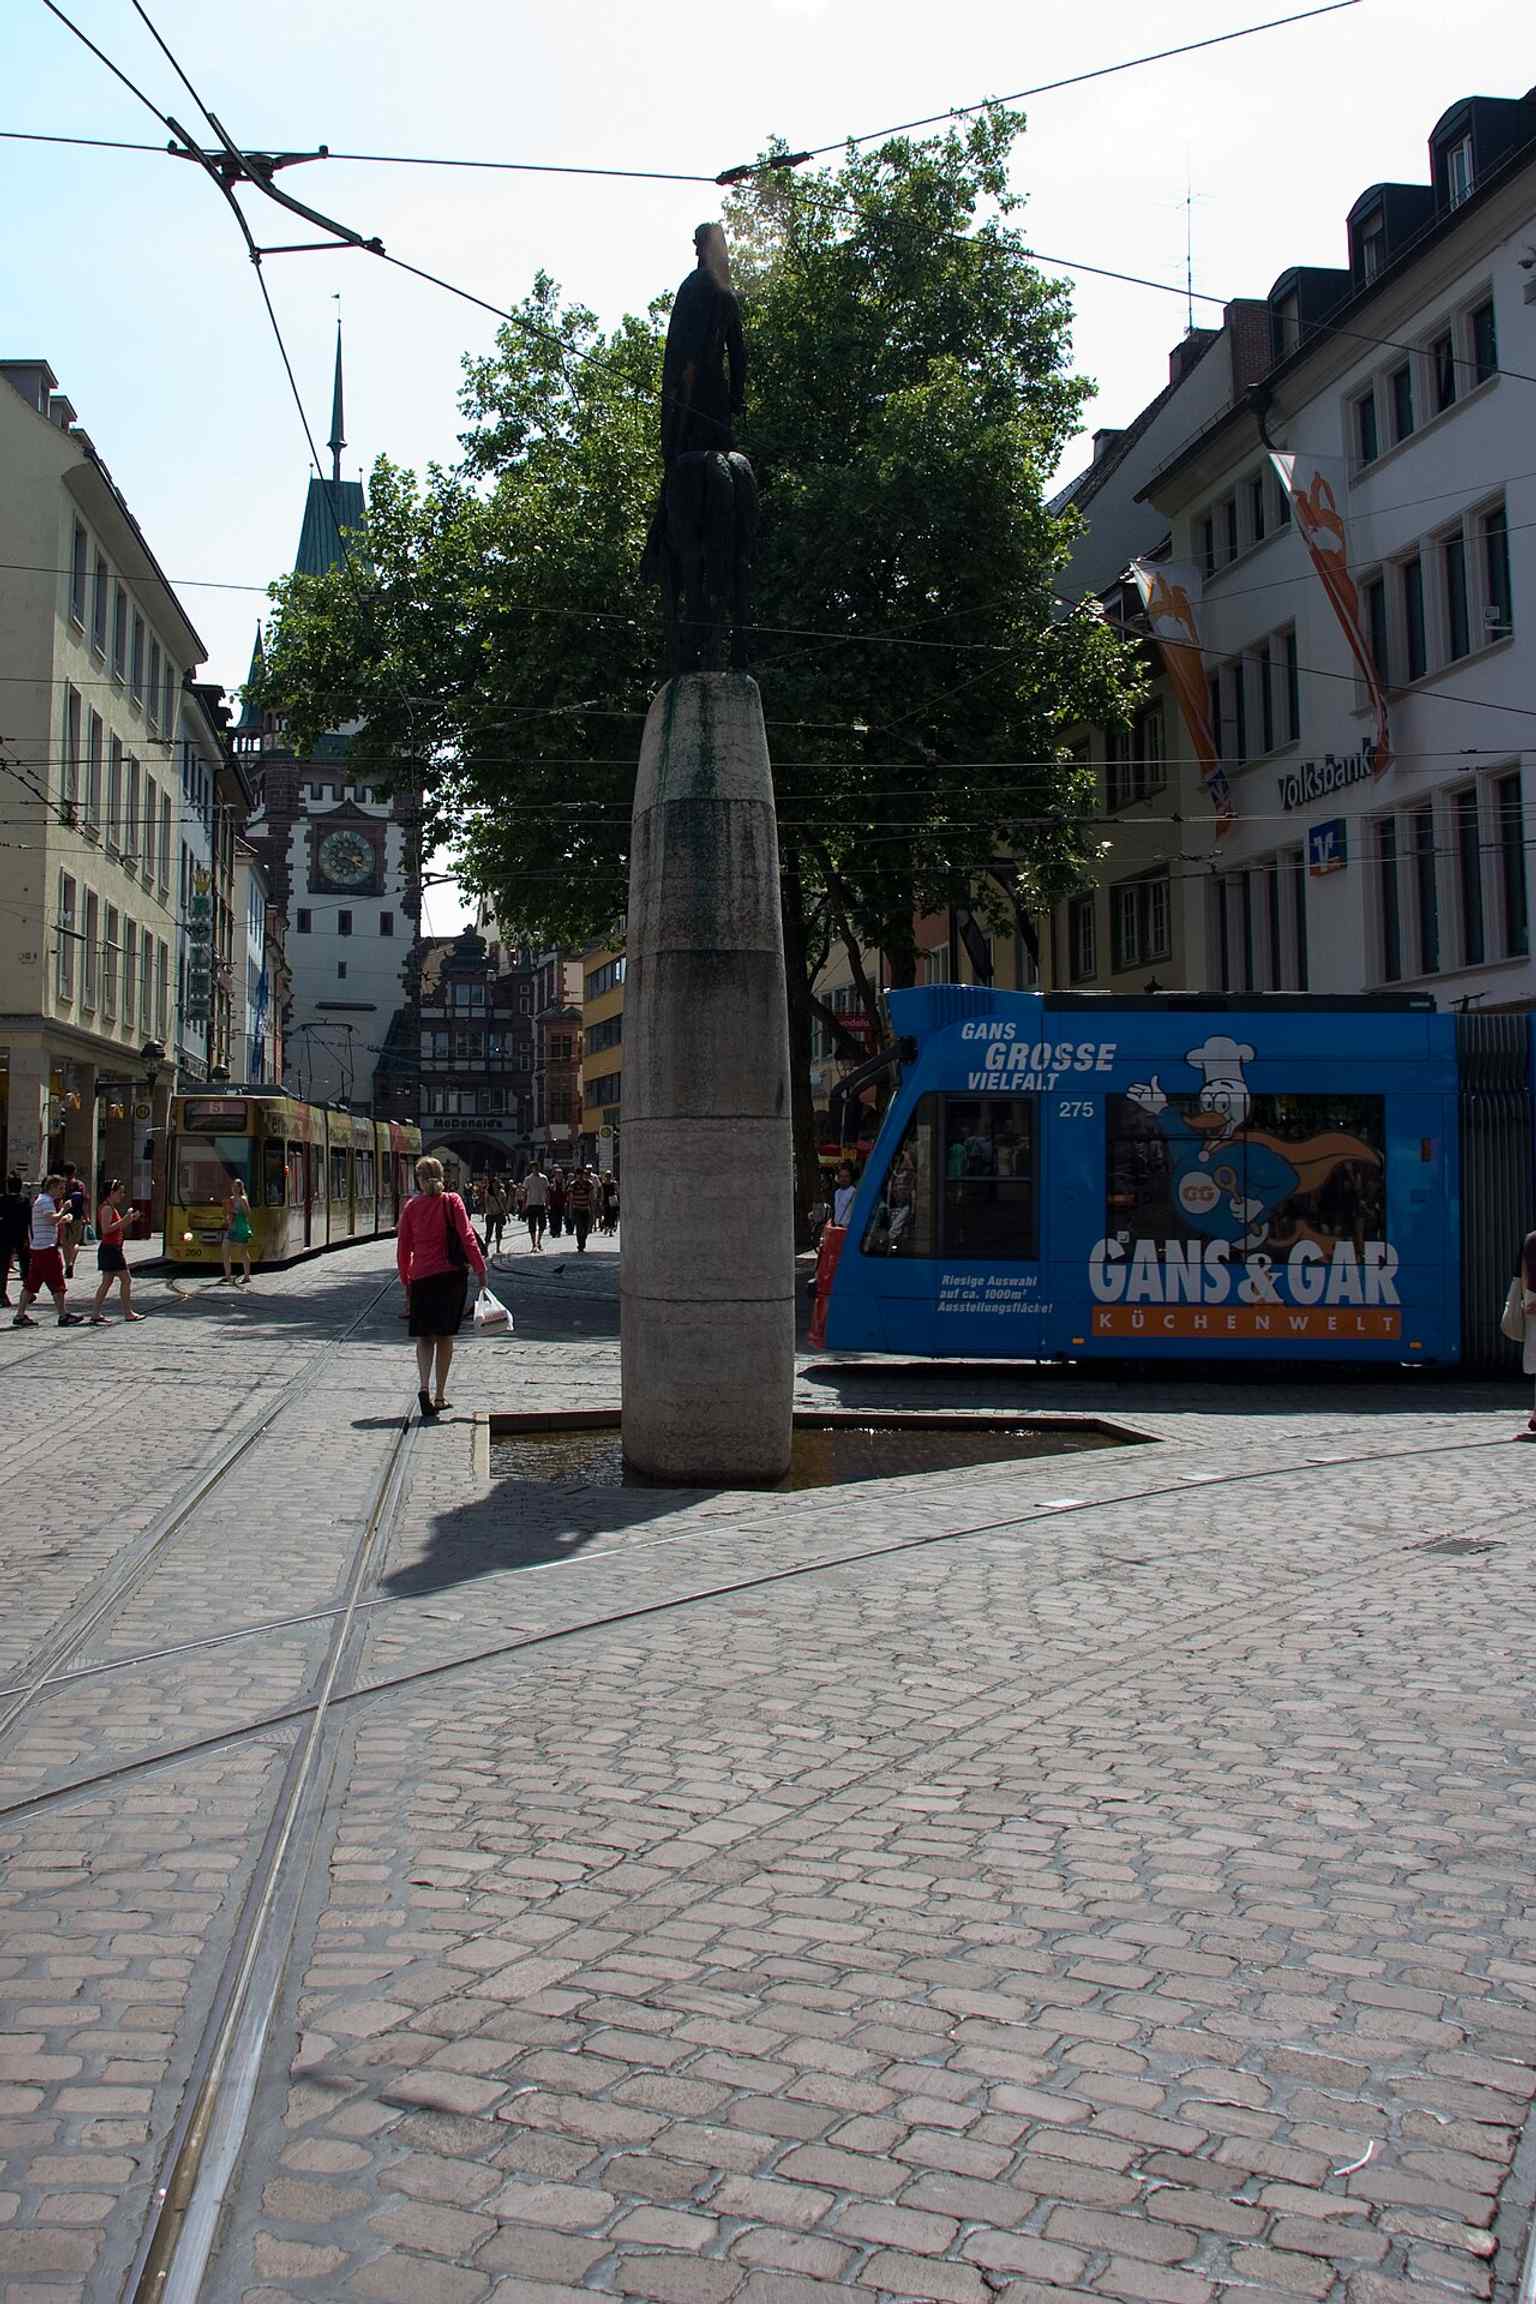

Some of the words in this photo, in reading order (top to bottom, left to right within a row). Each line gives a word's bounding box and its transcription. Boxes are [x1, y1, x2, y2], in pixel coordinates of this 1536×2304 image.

[1278, 737, 1376, 810] Volksbank
[960, 1022, 1017, 1040] GANS
[985, 1042, 1117, 1072] GROSSE
[968, 1072, 1060, 1091] VIELFALT
[1059, 1101, 1095, 1118] 275
[1089, 1238, 1232, 1304] GANS
[1237, 1252, 1285, 1305] &
[1288, 1239, 1401, 1305] GAR
[941, 1274, 985, 1288] Riesige
[987, 1275, 1038, 1287] Auswahl
[939, 1288, 960, 1300] auf
[962, 1291, 980, 1300] ca.
[937, 1301, 1053, 1315] Ausstellungsfläche!
[1100, 1309, 1393, 1331] KÜCHENWELT
